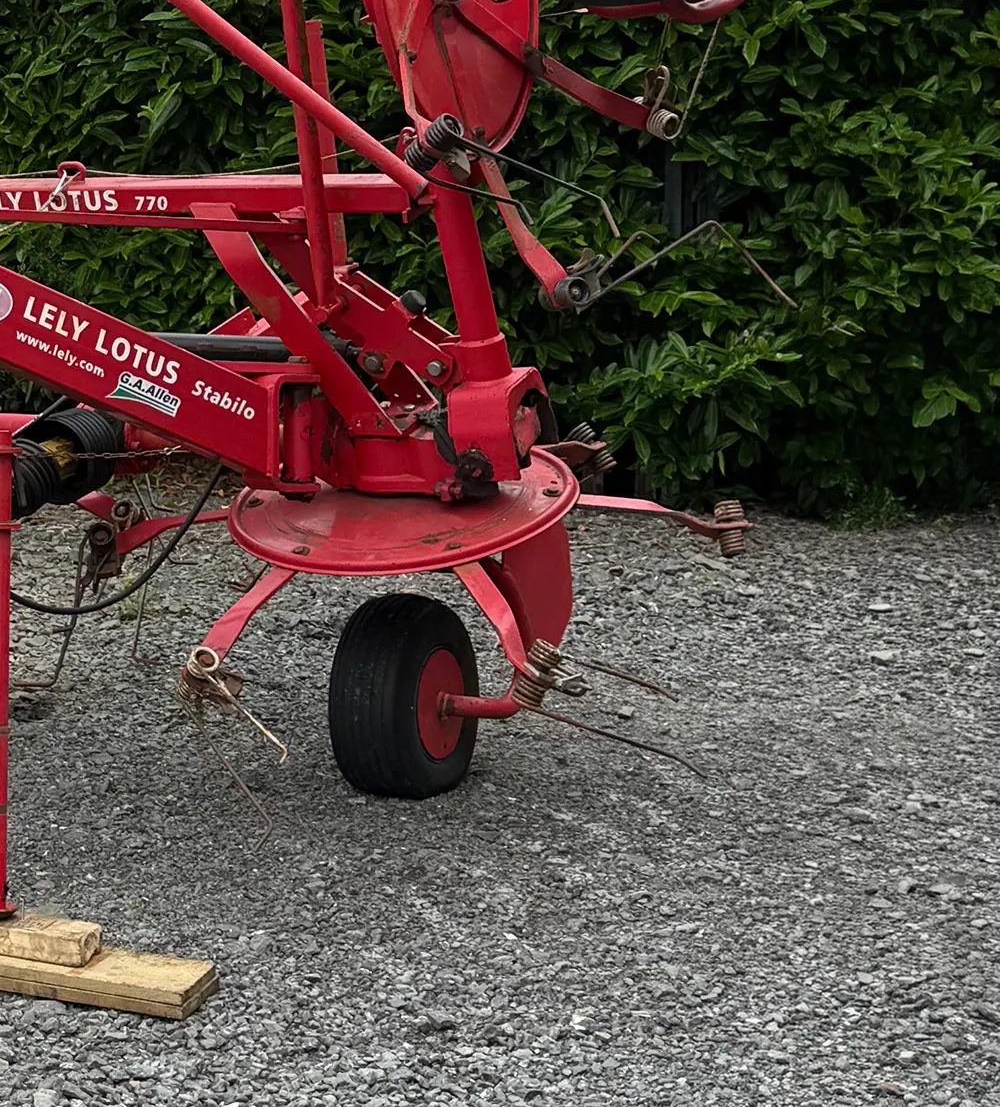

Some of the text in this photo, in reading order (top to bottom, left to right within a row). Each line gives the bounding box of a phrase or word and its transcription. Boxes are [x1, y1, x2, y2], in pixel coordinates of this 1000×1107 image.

[33, 190, 119, 212] LOTUS
[134, 196, 168, 211] 770
[16, 330, 105, 378] www.lely.com
[23, 296, 256, 420] LELY LOTUS Stabilo
[120, 373, 179, 407] G.A.Allen
